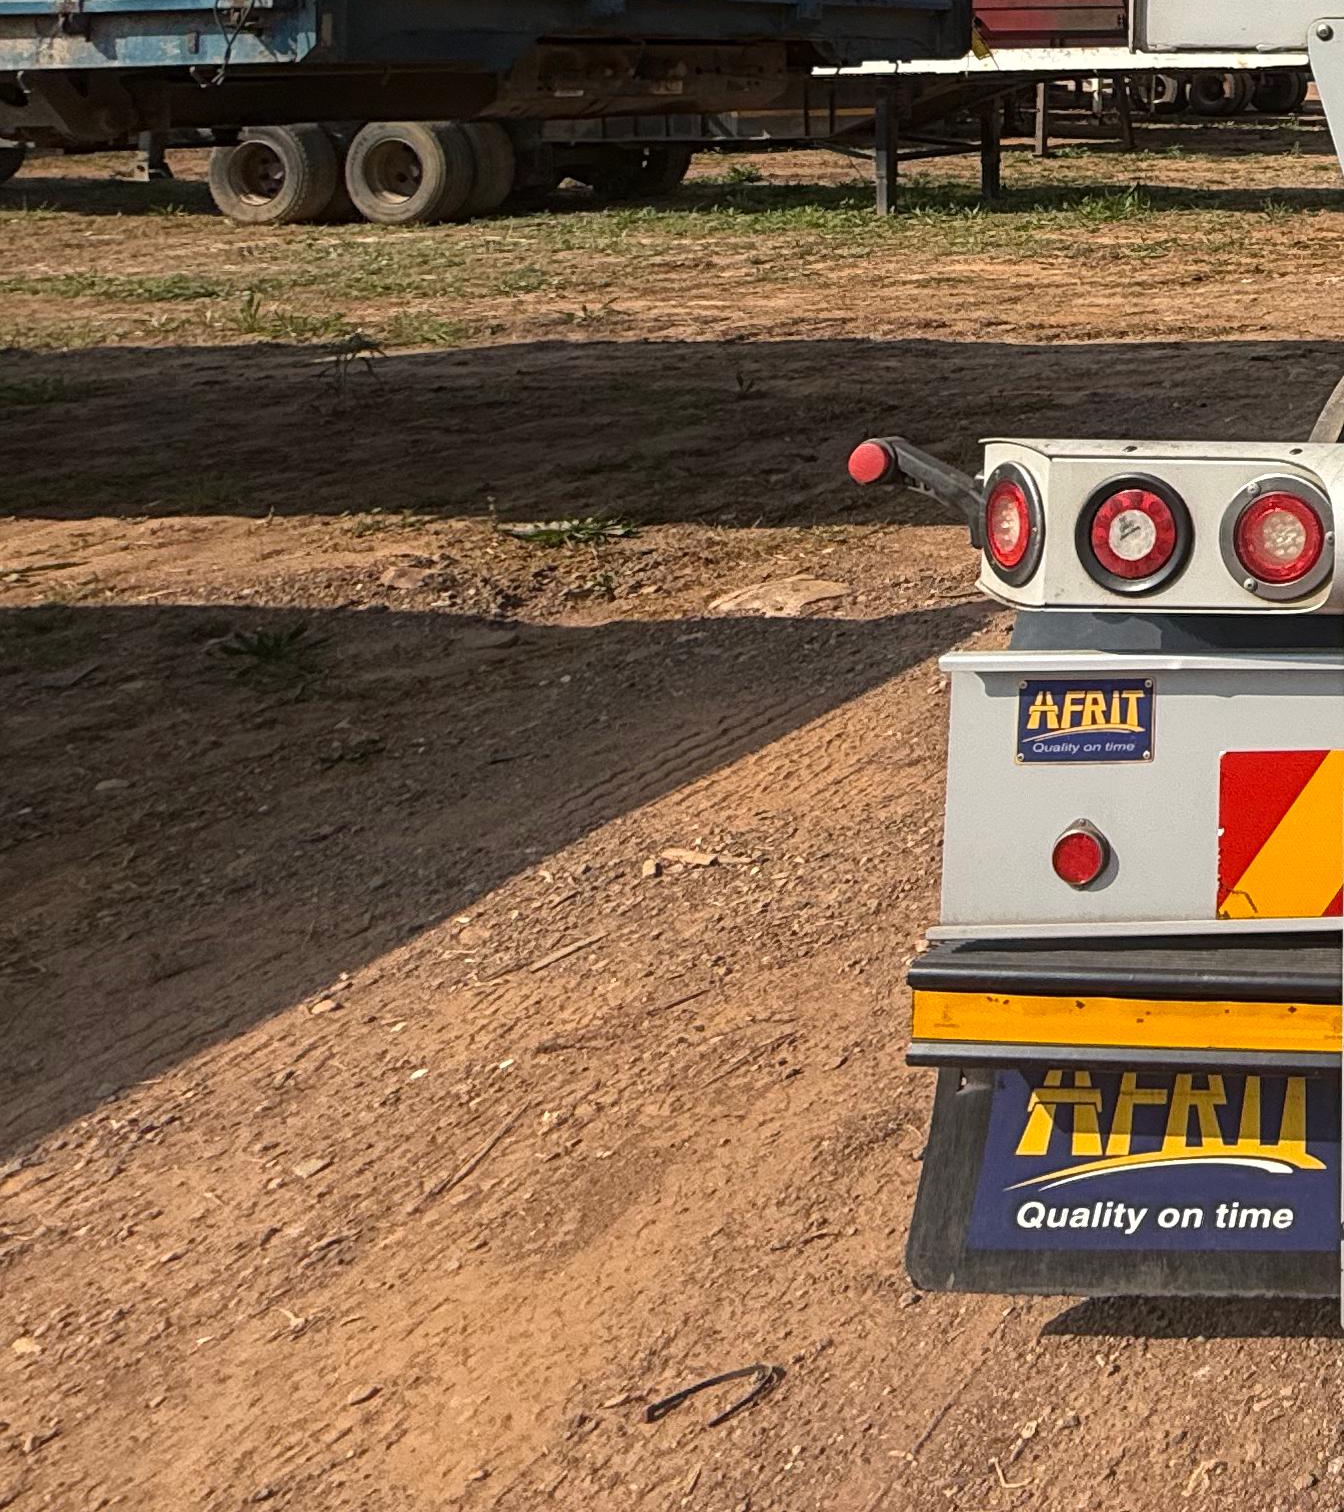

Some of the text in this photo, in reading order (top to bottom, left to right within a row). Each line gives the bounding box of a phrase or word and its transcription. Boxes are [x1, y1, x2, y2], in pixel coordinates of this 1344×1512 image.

[1032, 742, 1136, 754] Quality on time
[1016, 1201, 1294, 1234] Quality on time
